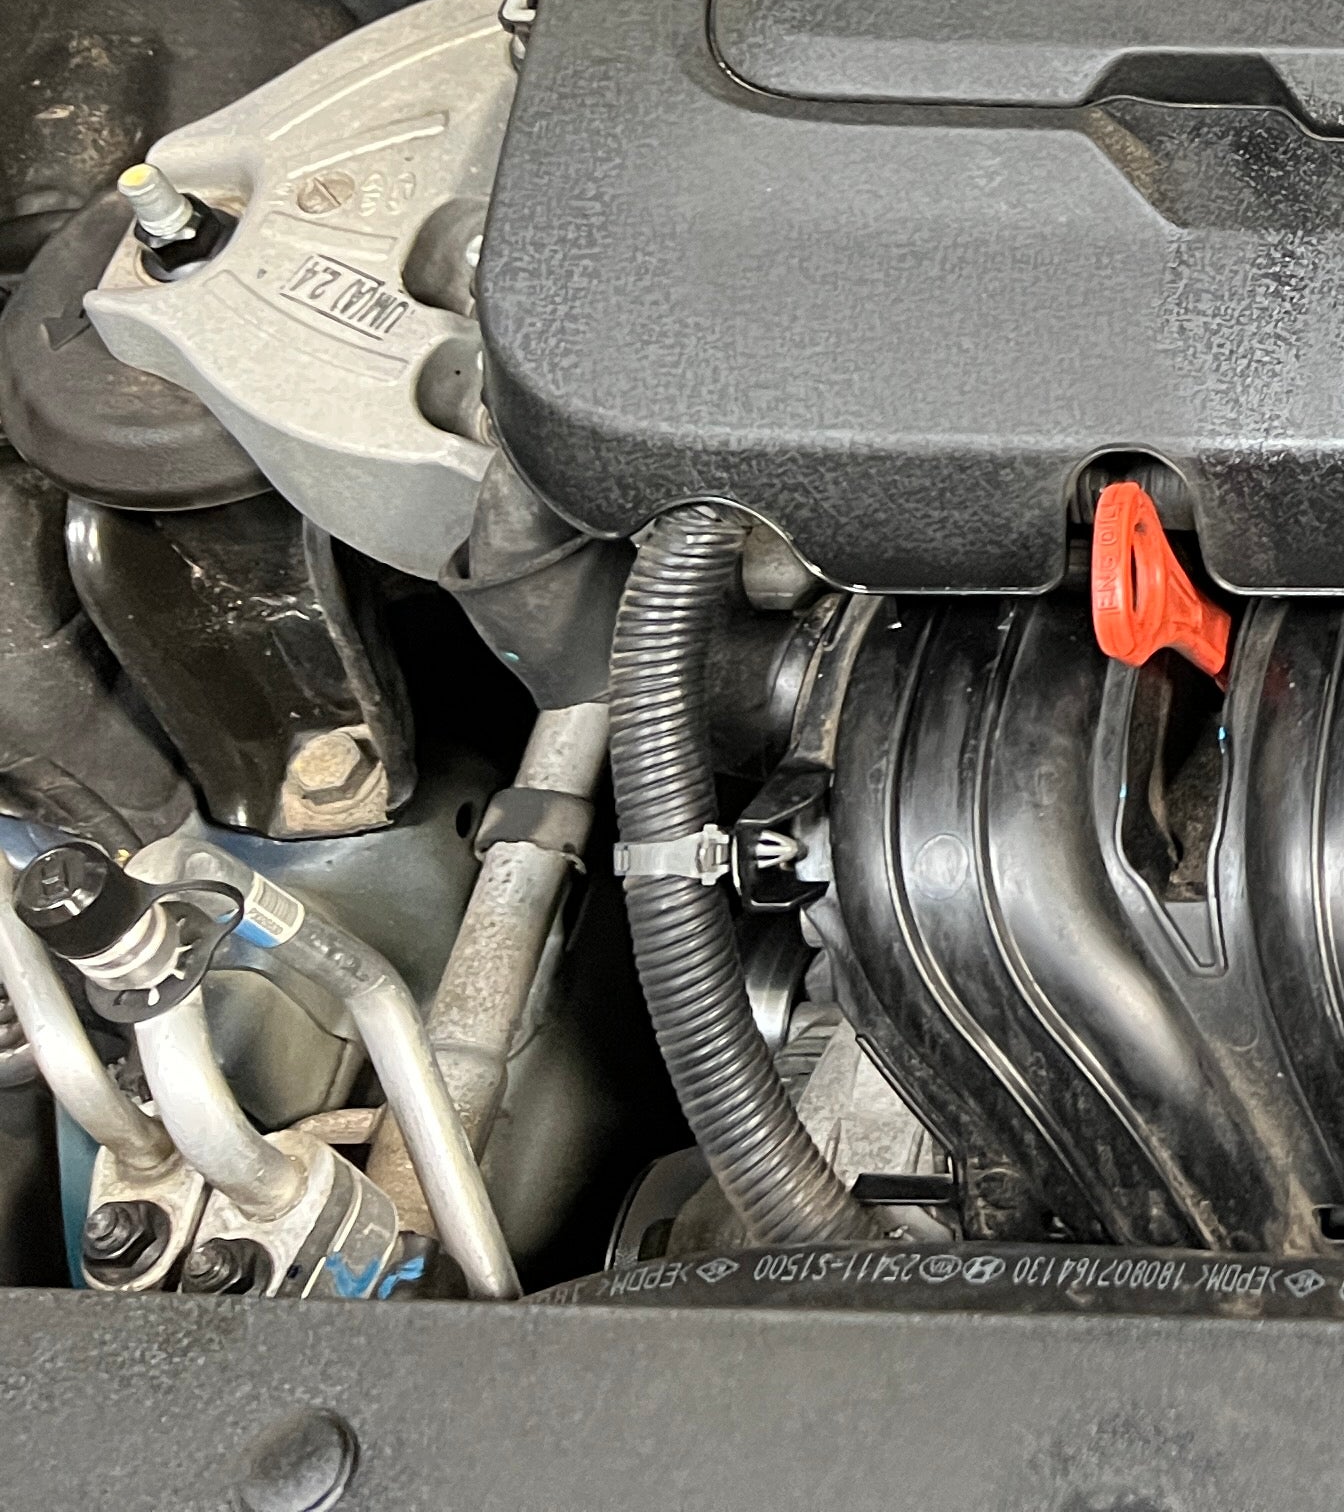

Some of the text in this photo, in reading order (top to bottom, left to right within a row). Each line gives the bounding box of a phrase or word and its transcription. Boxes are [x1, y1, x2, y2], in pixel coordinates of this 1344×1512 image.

[1097, 502, 1122, 615] ENG OIL
[753, 1252, 924, 1283] 25411-S1500
